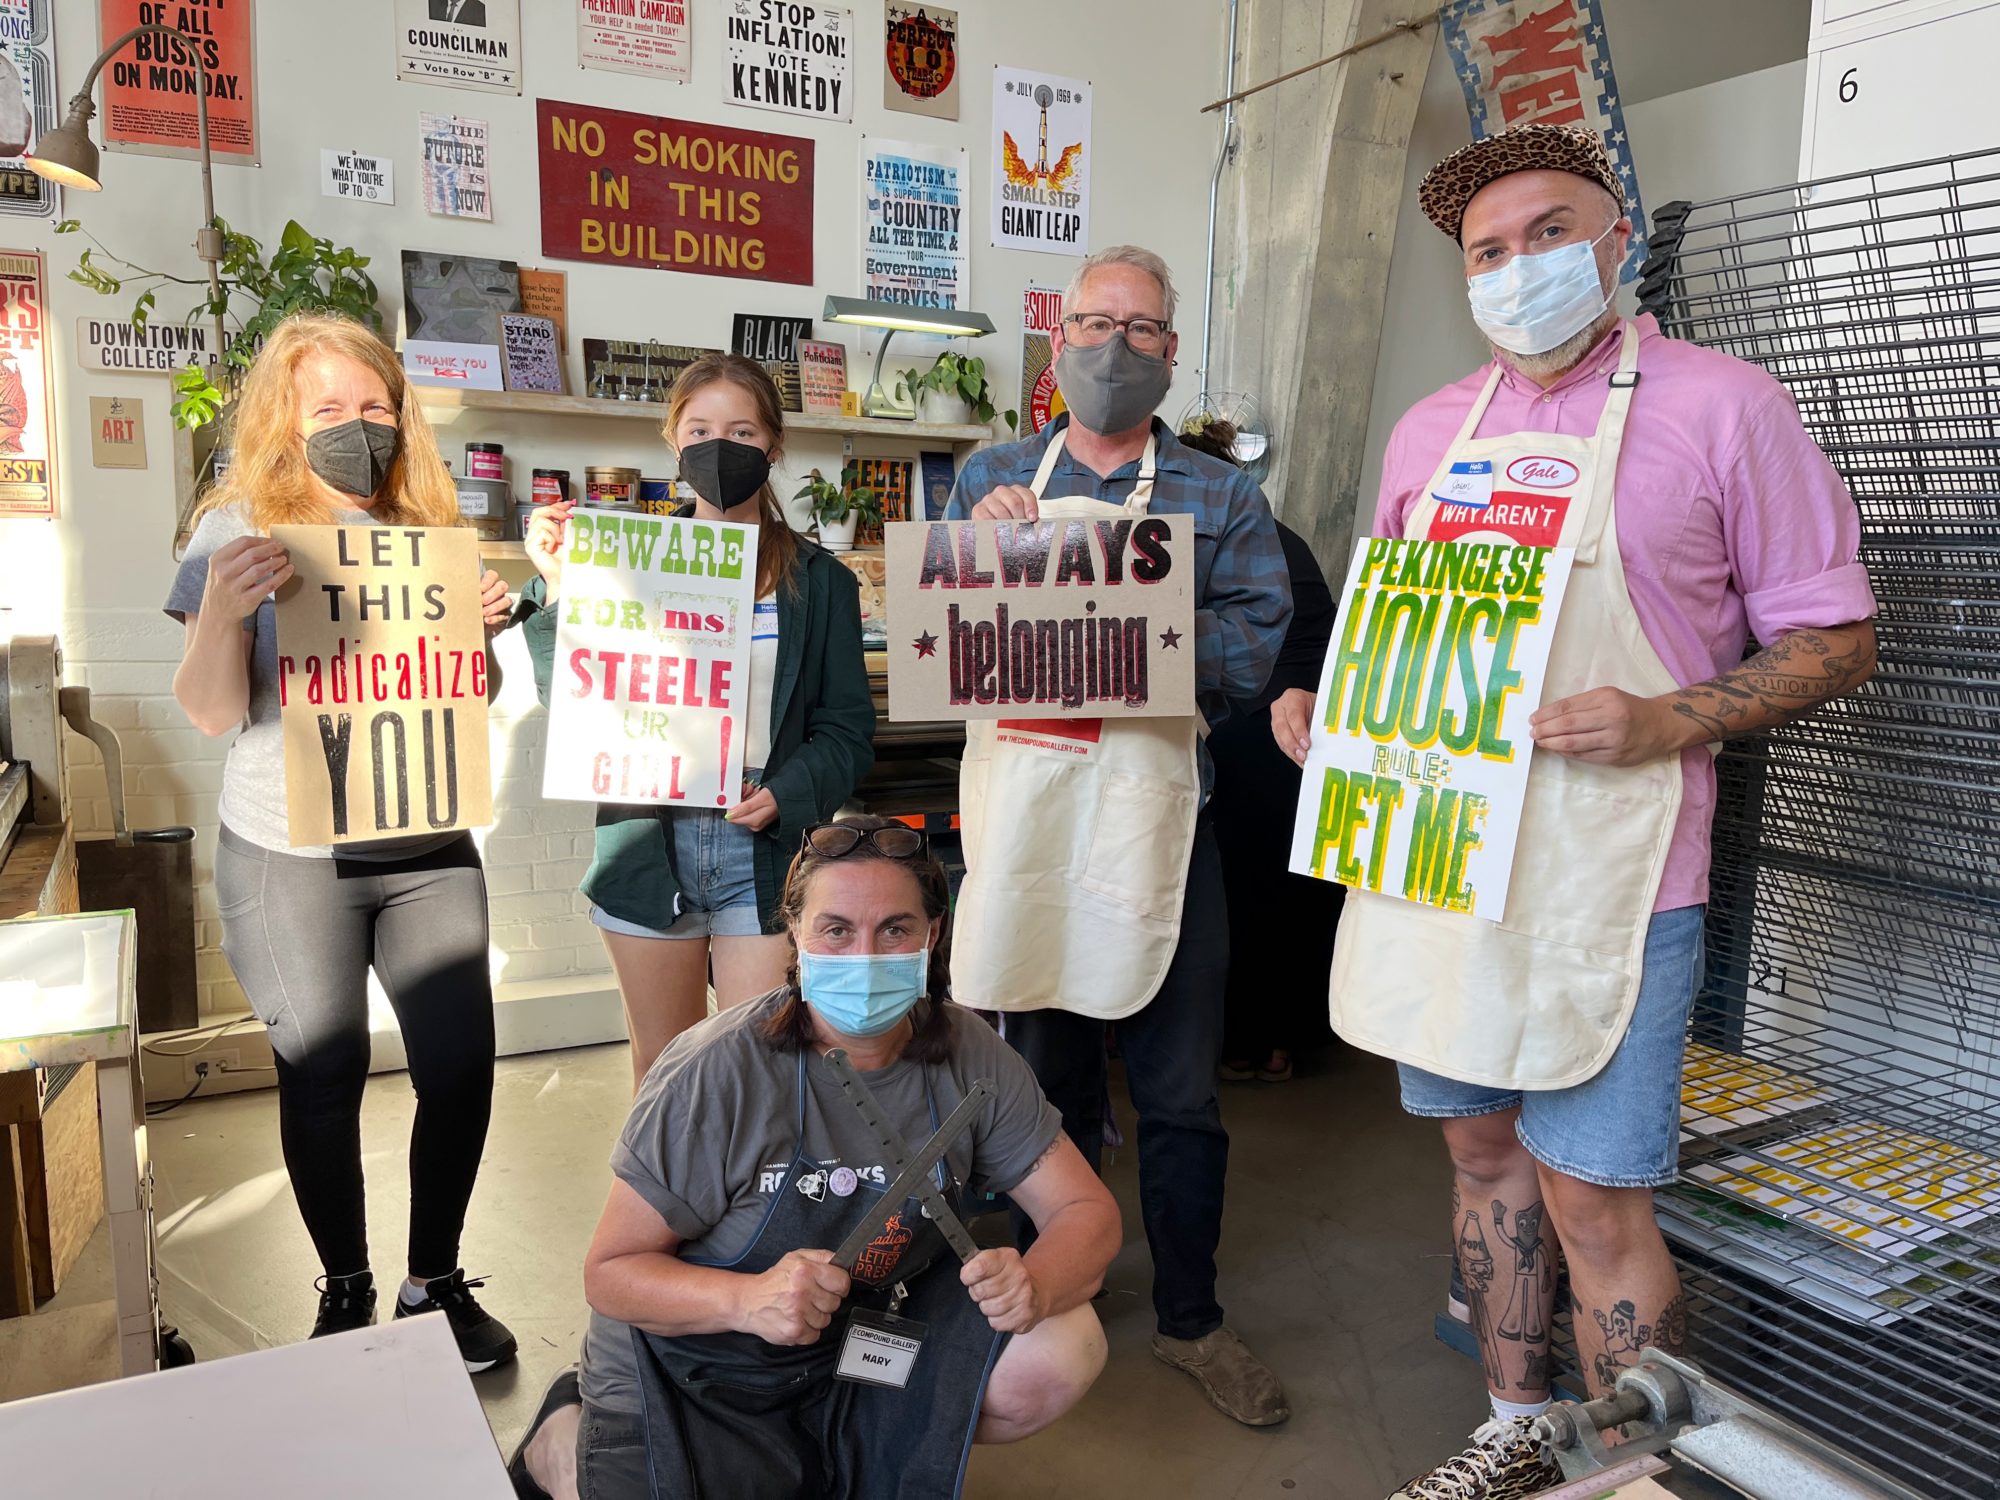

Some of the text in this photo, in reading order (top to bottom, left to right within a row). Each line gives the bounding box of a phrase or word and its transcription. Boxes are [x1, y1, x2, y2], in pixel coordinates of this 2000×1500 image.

[177, 7, 214, 36] ALL
[640, 0, 685, 25] CAMPAIGN
[759, 0, 816, 28] STOP
[915, 8, 929, 25] A
[408, 29, 508, 58] COUNCILMAN
[728, 16, 846, 58] INFLATION!
[887, 20, 955, 51] PERFECT
[113, 61, 142, 89] ON
[424, 63, 449, 74] Vote
[453, 67, 475, 77] Row
[768, 52, 809, 72] VOTE
[732, 62, 842, 114] KENNEDY
[1017, 82, 1071, 103] JULY 1969
[1838, 67, 1859, 103] 6
[449, 125, 484, 138] THE
[337, 155, 377, 172] WE KNOW
[424, 138, 484, 168] FUTURE
[552, 116, 799, 184] NO SMOKING
[332, 168, 384, 186] WHAT YOU'RE
[470, 174, 485, 184] IS
[867, 159, 945, 185] PATRIOTISM
[338, 182, 362, 197] UP TO
[455, 188, 485, 213] NOW
[590, 171, 761, 226] IN THIS
[882, 186, 959, 206] IS SUPPORTING YOUR
[1002, 183, 1080, 209] SMALL STEP
[883, 200, 961, 233] COUNTRY
[1002, 206, 1081, 243] GIANT LEAP
[581, 218, 766, 271] BUILDING
[869, 225, 958, 251] ALL THE TIME, &
[866, 257, 958, 281] government
[906, 250, 924, 262] YOUR
[907, 278, 926, 289] WHEN
[90, 321, 205, 351] DOWNTOWN
[504, 325, 551, 339] STAND
[743, 319, 804, 361] BLACK
[102, 347, 176, 369] COLLEGE
[415, 354, 487, 369] THANK YOU
[803, 350, 842, 367] Politicians
[102, 419, 135, 442] ART
[1522, 462, 1560, 481] Gale
[1441, 504, 1557, 527] WHY AREN'T
[337, 528, 425, 567] LET
[568, 514, 745, 580] BEWARE
[918, 518, 1172, 589] ALWAYS
[1357, 537, 1554, 602] PEKINGESE
[321, 584, 446, 621] THIS
[566, 595, 648, 631] FOR
[664, 609, 725, 633] ms
[947, 600, 1148, 711] belonging
[279, 635, 486, 707] radicalize
[569, 648, 732, 709] STEELE
[1324, 588, 1541, 762] HOUSE
[623, 709, 669, 742] UR
[317, 707, 458, 839] YOU
[591, 751, 686, 800] GIRL
[1371, 744, 1453, 789] RULE:
[1309, 766, 1491, 916] PET ME
[858, 1249, 900, 1266] LETTER
[857, 1329, 917, 1350] COMPOUND GALLERY
[862, 1352, 892, 1367] MARY
